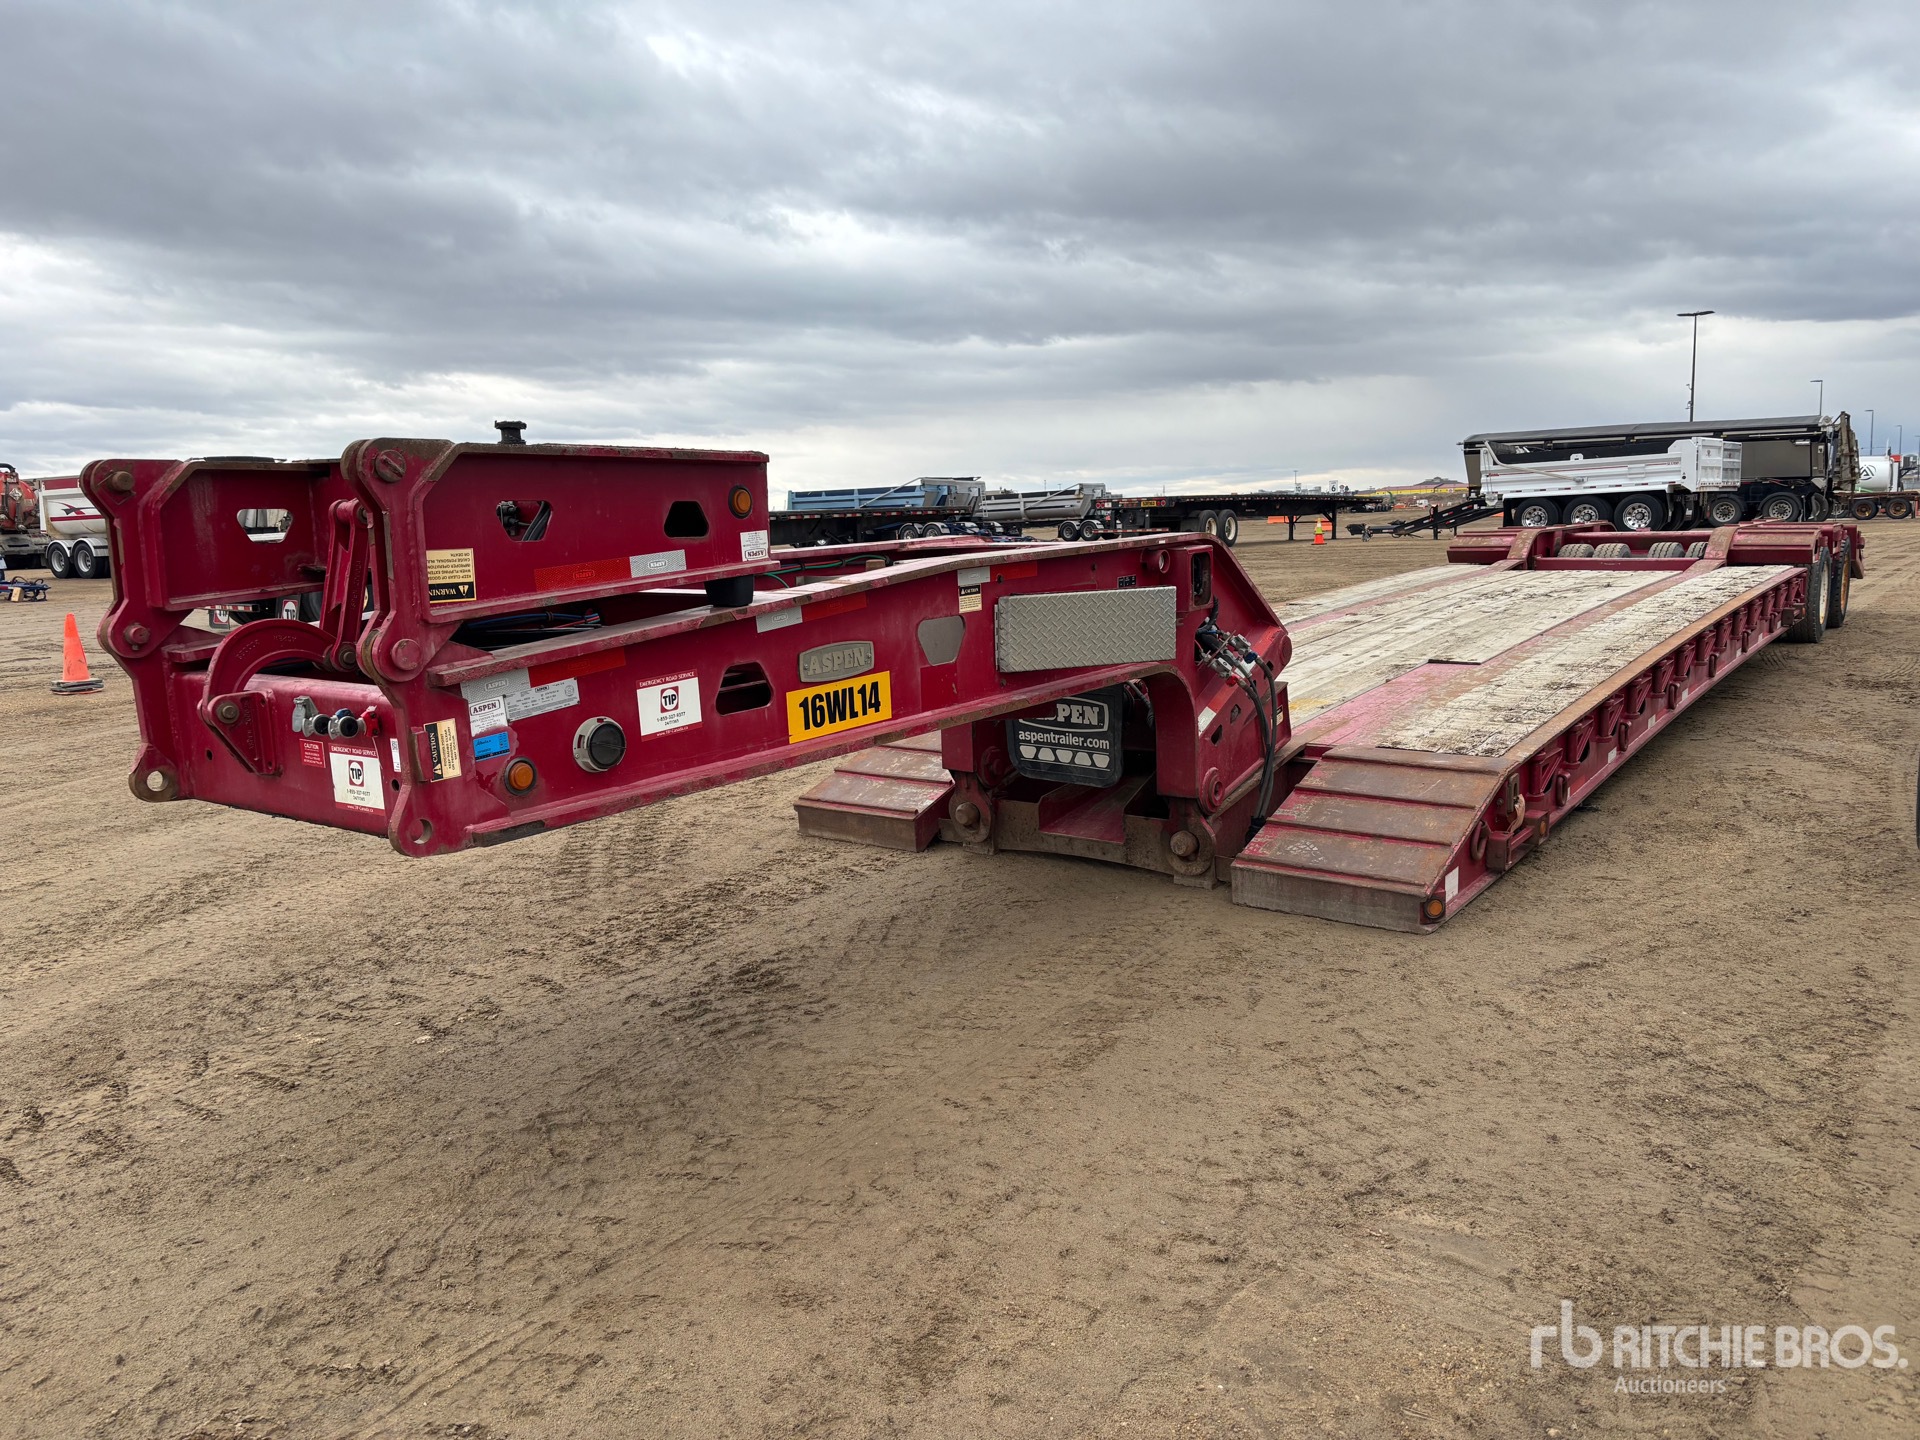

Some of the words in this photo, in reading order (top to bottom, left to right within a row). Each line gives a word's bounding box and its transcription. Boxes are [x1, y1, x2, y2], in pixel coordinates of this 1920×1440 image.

[428, 588, 456, 596] WARNIN
[807, 646, 865, 676] ASPEN
[488, 680, 506, 689] ASPEN
[640, 678, 665, 687] EMERGENCY
[663, 694, 677, 706] TIP
[799, 681, 881, 730] 16WL14
[472, 702, 497, 713] ASPEN
[1037, 704, 1100, 725] PEN
[1019, 730, 1110, 749] aspentrailer.com
[430, 732, 438, 762] CAUTION
[350, 768, 362, 780] TIP
